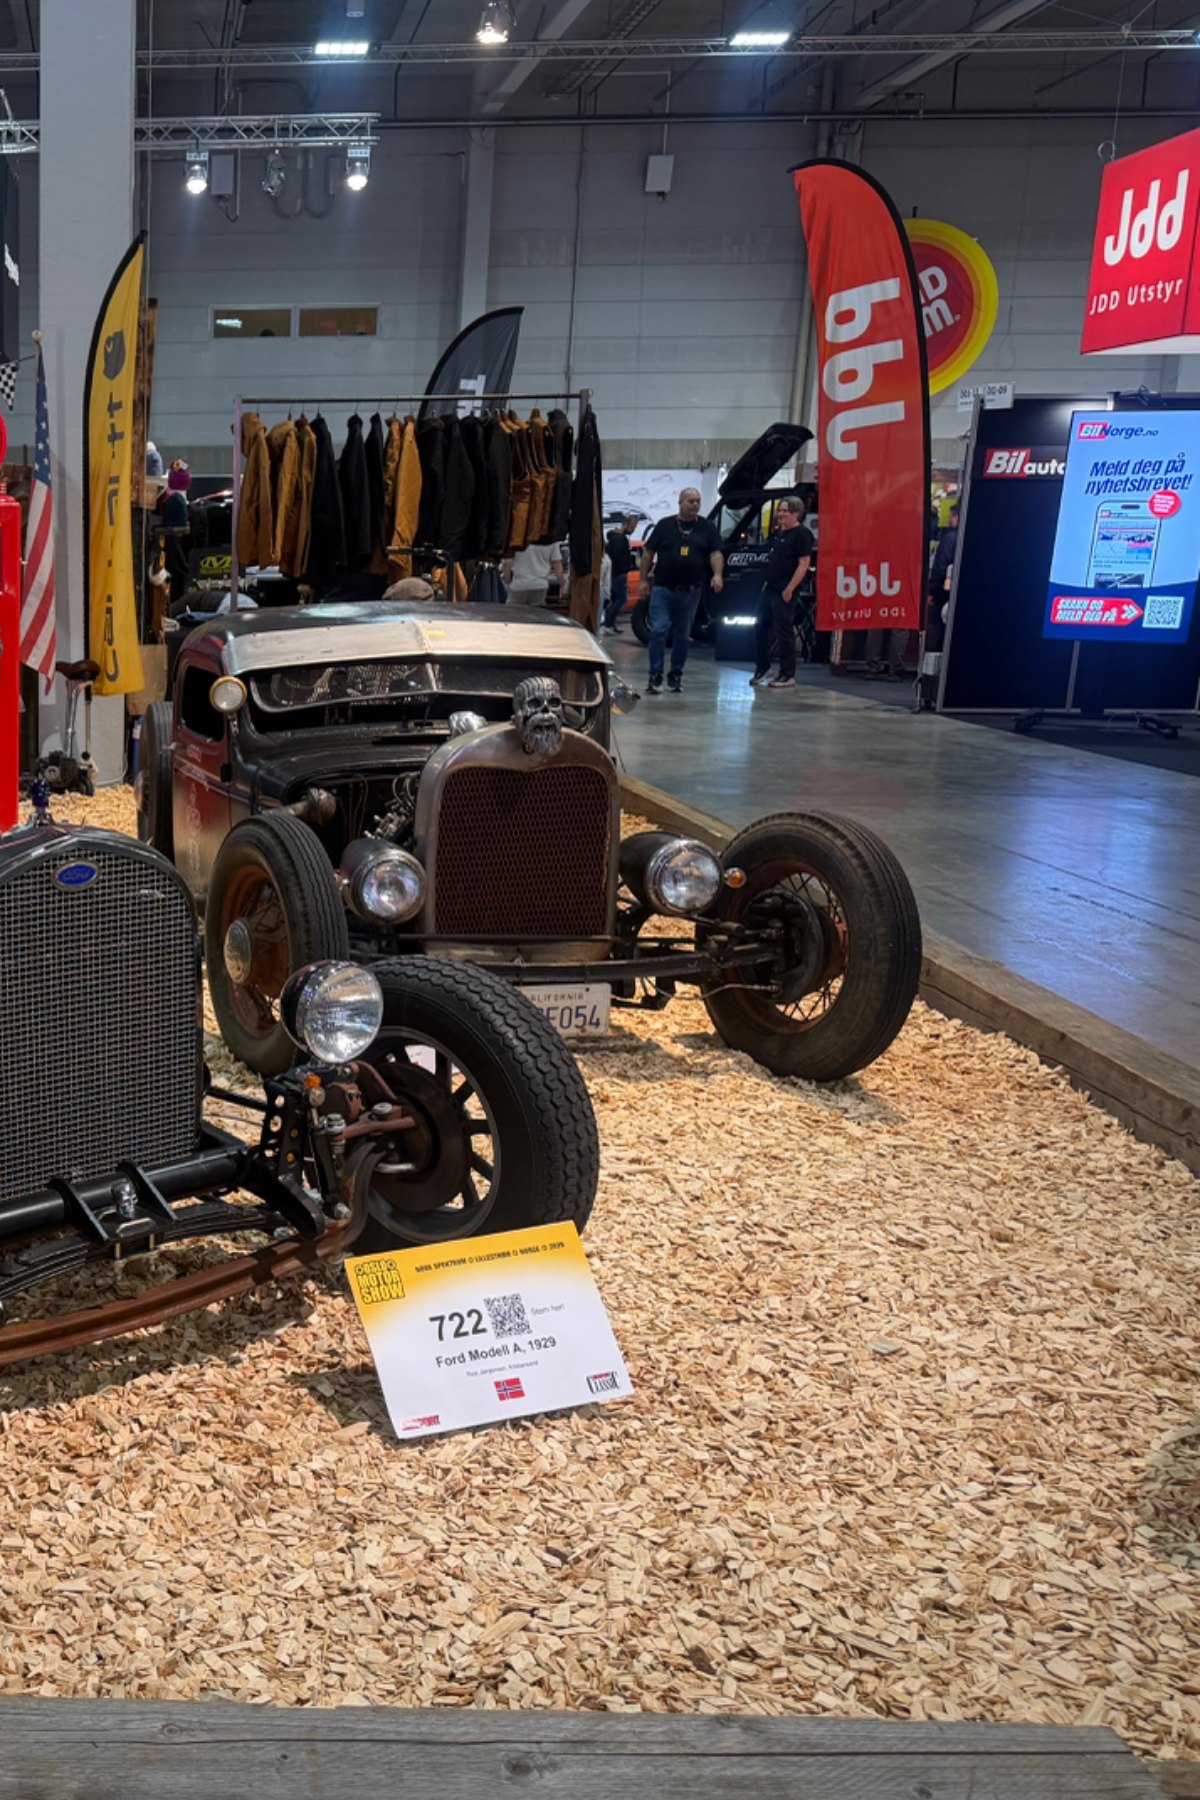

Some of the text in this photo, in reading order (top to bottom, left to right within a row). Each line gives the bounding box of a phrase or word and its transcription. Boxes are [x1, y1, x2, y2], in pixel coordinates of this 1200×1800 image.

[1104, 169, 1189, 266] Jdd
[1089, 278, 1183, 316] JDD Utstyr
[1090, 452, 1186, 477] Meld deg på
[1085, 474, 1193, 497] nyhetsbrevet!
[528, 992, 585, 1002] ALIFORNIA
[357, 1269, 401, 1289] MOTOR
[361, 1260, 388, 1274] OSLO
[361, 1281, 405, 1304] SHOW
[429, 1308, 488, 1342] 722
[435, 1336, 557, 1368] Ford Modell A, 1929
